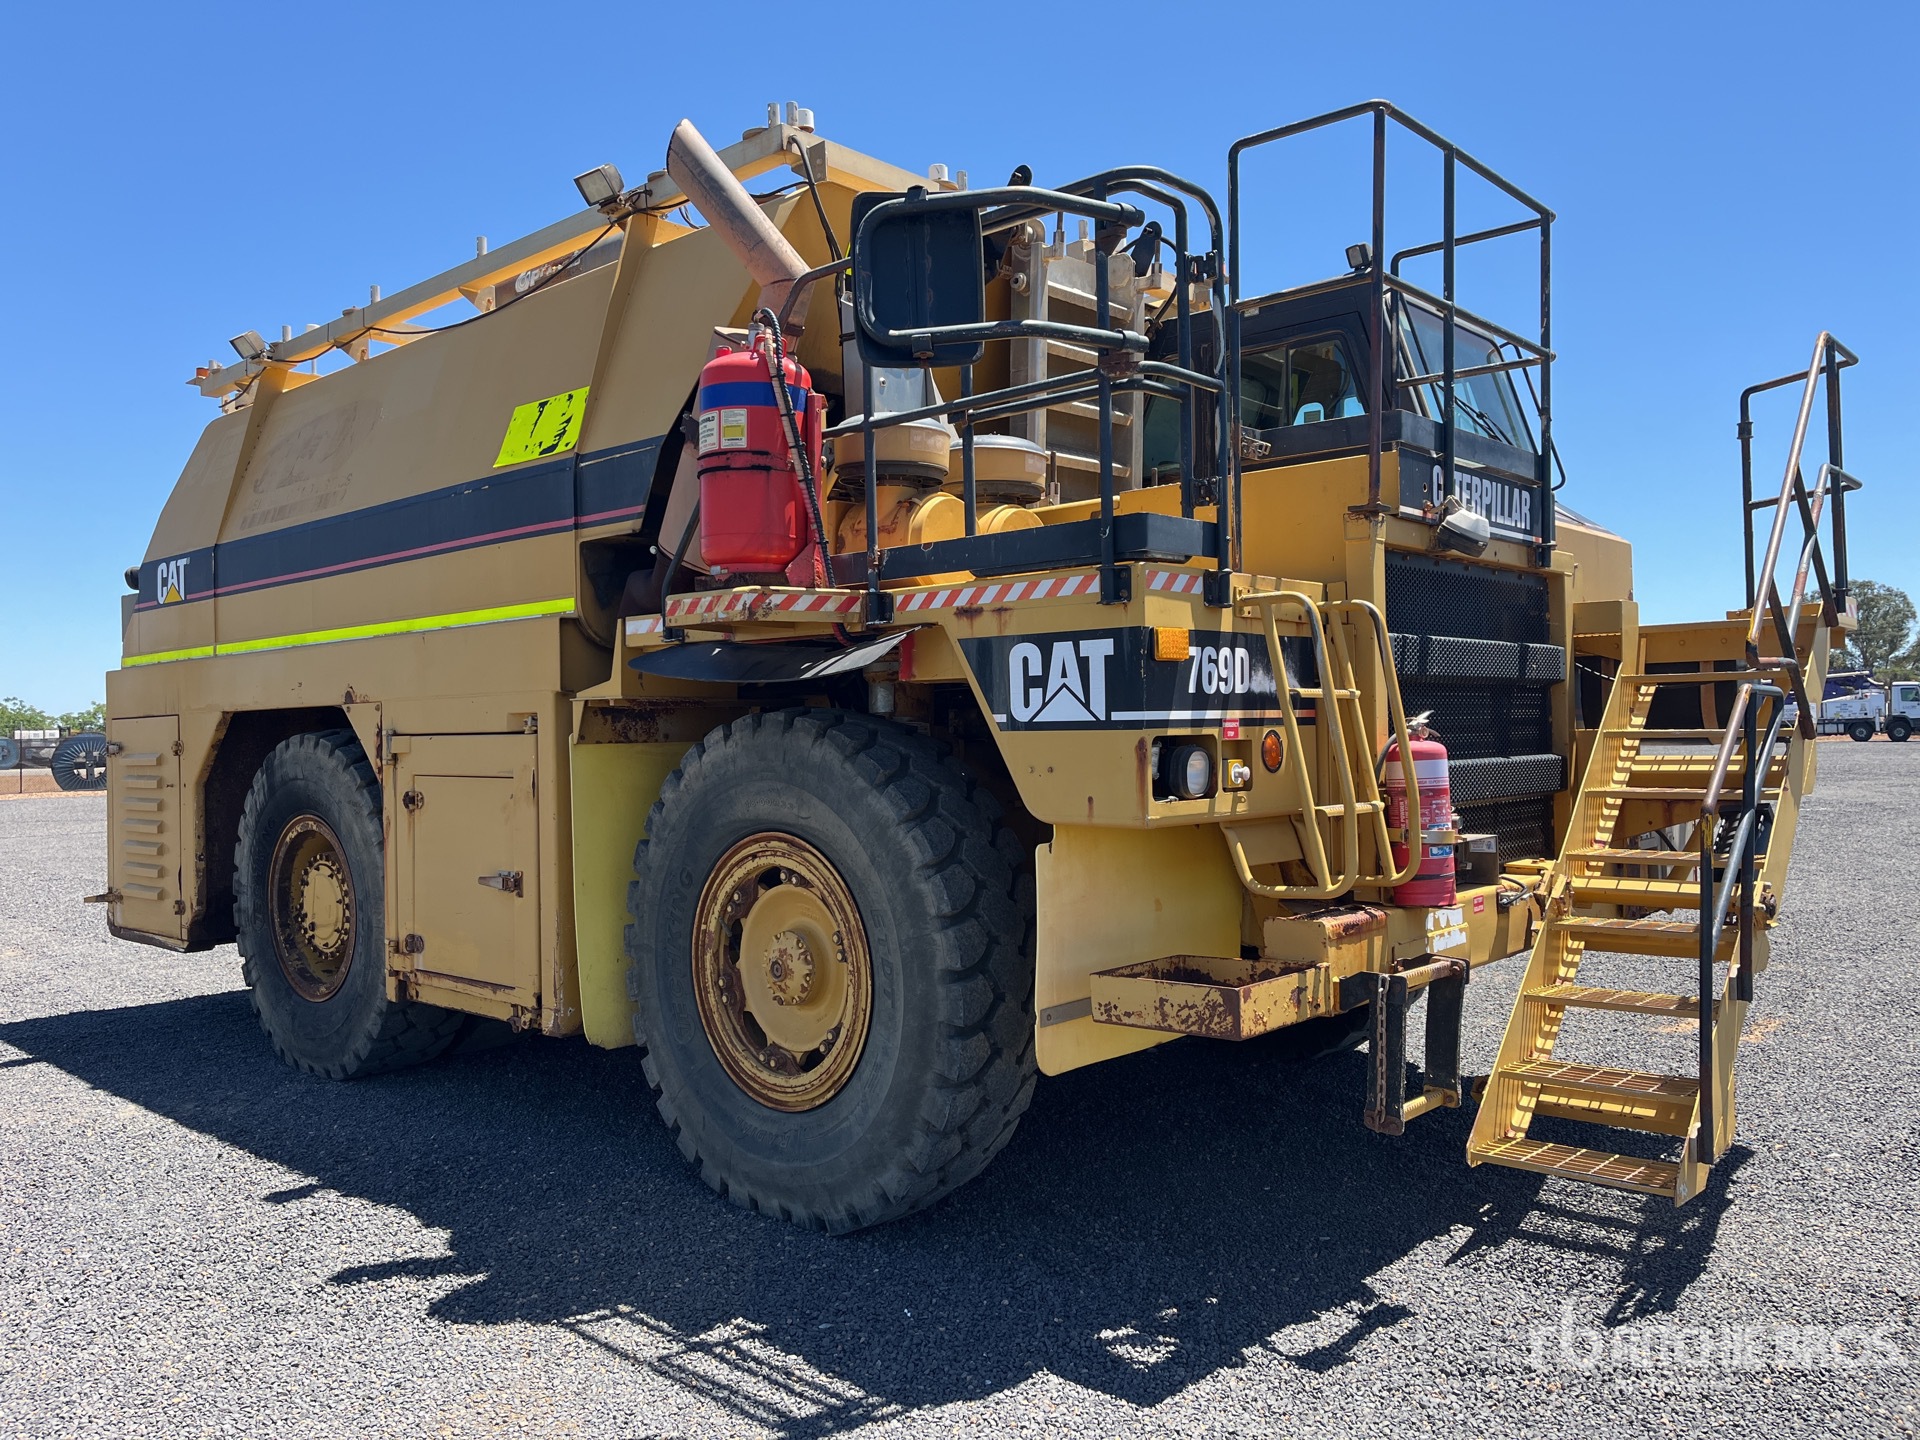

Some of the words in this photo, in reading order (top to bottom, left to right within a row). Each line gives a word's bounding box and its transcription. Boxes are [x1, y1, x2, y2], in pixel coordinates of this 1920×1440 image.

[1432, 464, 1531, 531] CTERPILLAR
[157, 557, 188, 605] CAT
[1009, 638, 1114, 722] CAT
[1188, 646, 1250, 695] 769D
